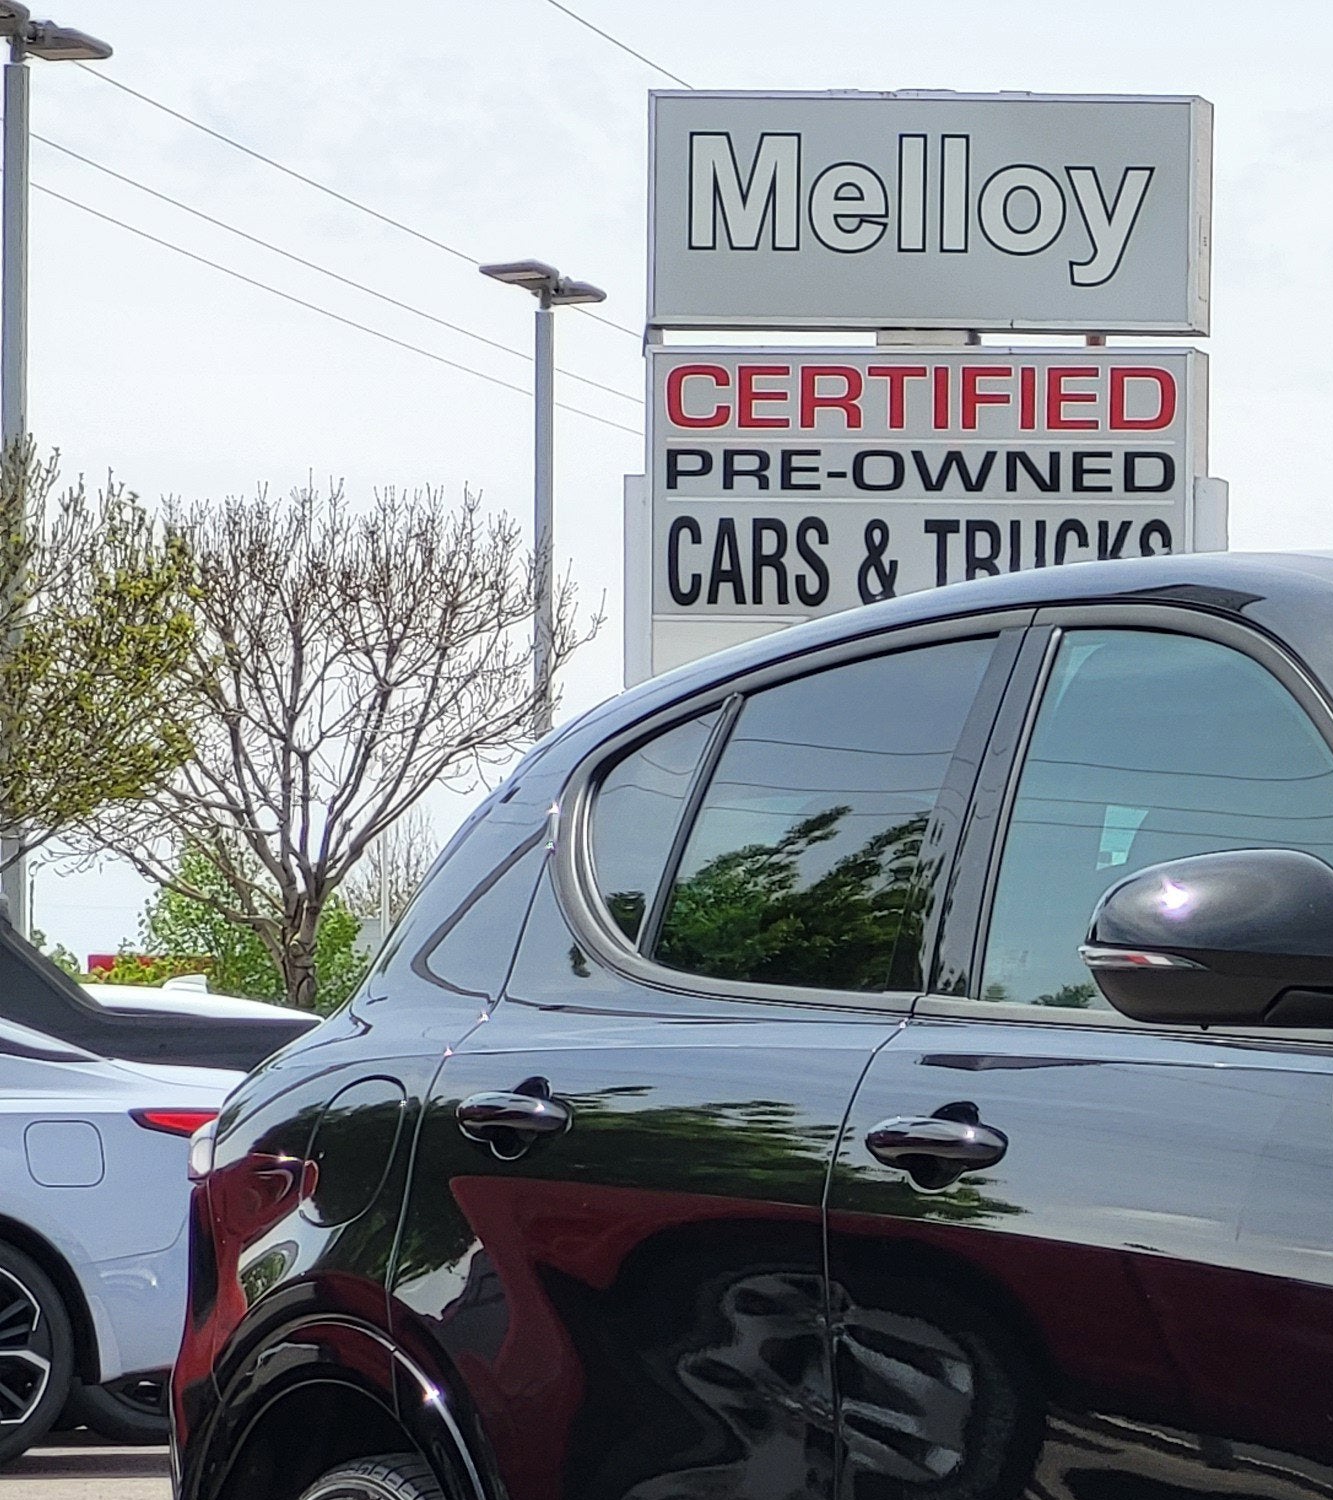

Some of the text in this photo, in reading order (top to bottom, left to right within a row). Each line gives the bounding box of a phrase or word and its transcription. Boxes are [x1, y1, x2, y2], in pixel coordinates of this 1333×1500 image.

[687, 131, 1156, 287] Melloy
[665, 362, 1177, 431] CERTIFIED
[666, 448, 1176, 494] PRE-OWNED
[668, 515, 830, 607] CARS
[857, 518, 899, 605] &
